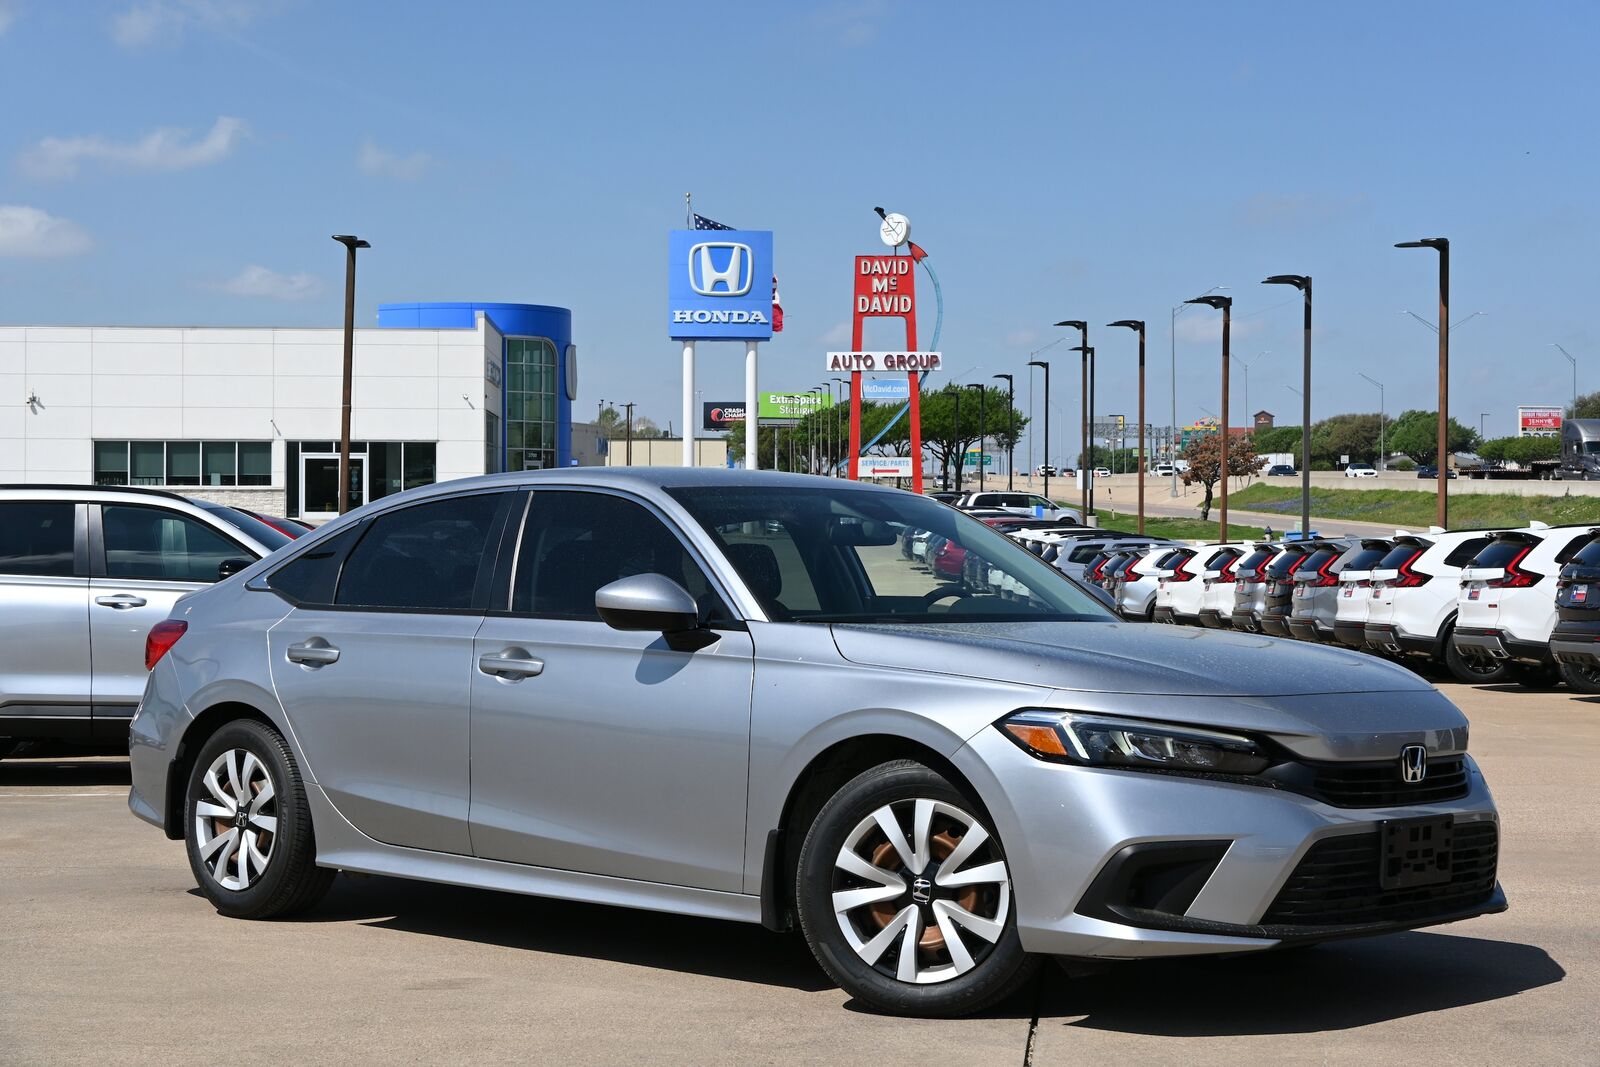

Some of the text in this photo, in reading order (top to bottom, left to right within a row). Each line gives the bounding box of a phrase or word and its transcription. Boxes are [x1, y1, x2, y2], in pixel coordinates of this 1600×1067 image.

[861, 259, 909, 275] DAVID
[858, 296, 913, 314] DAVID
[673, 310, 769, 324] HONDA
[831, 354, 940, 370] AUTO GROUP
